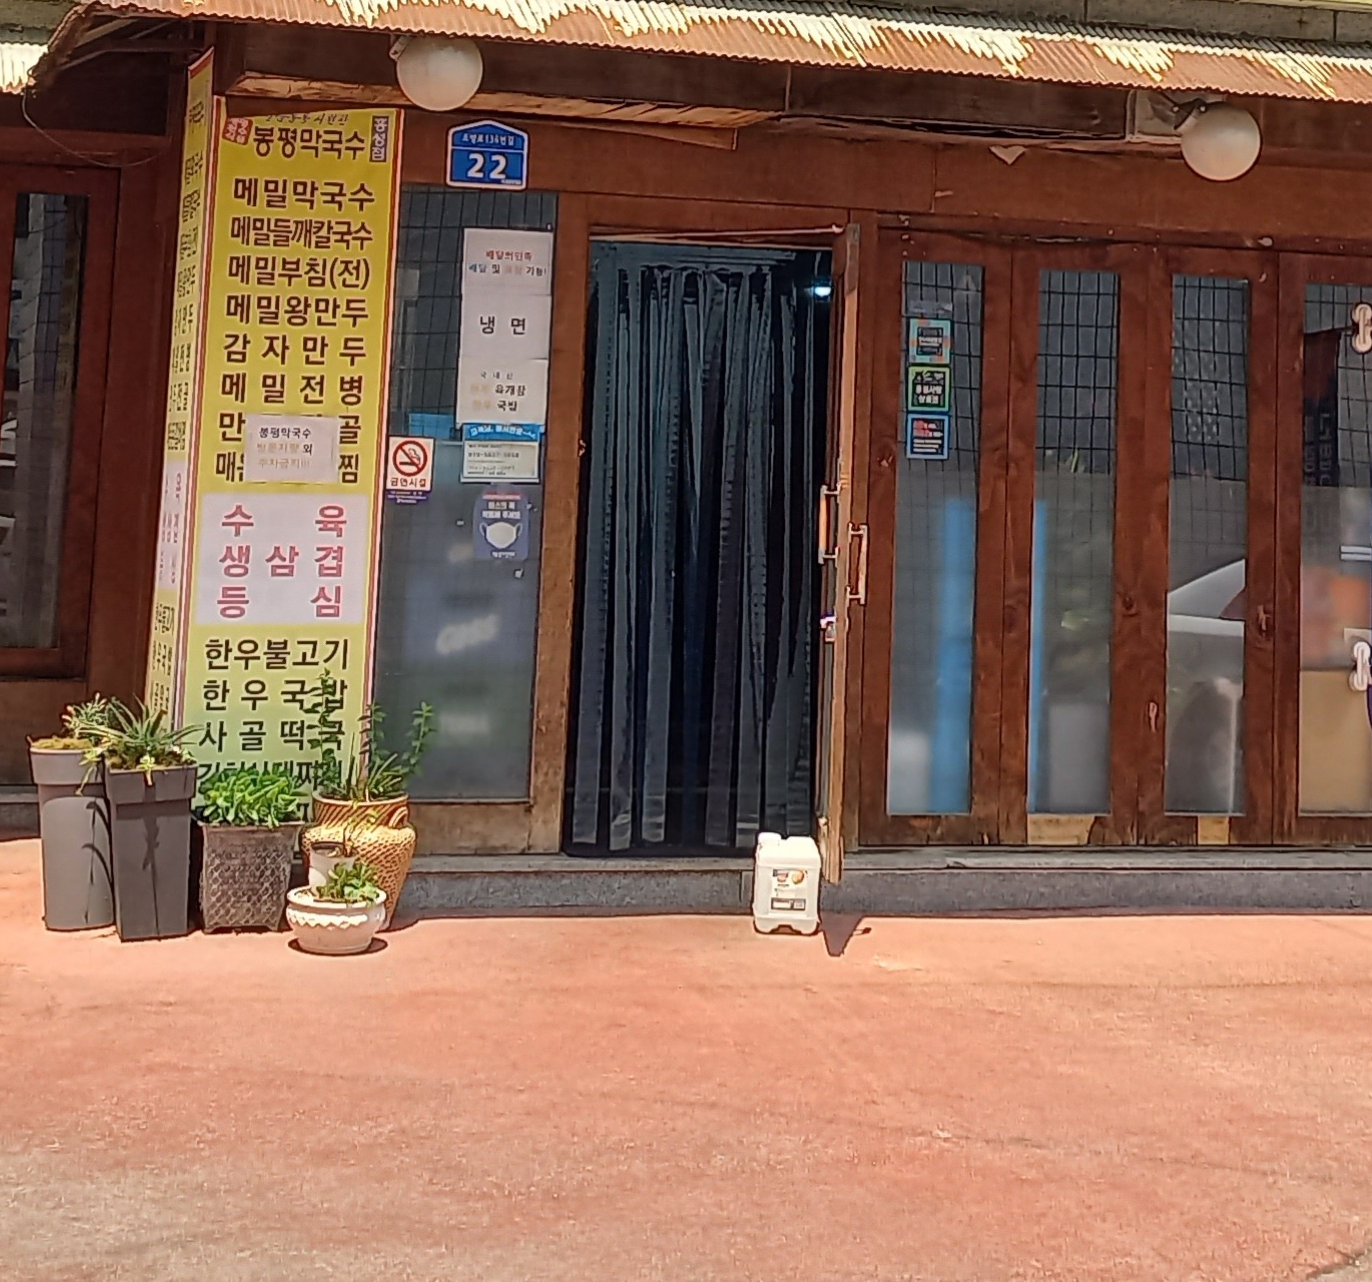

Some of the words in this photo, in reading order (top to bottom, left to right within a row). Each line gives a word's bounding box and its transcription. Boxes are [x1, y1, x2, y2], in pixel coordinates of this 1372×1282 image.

[253, 125, 366, 161] 봉평막국수
[467, 152, 507, 179] 22
[233, 177, 376, 212] 메밀막국수
[230, 216, 374, 251] 메밀들깨칼국수
[228, 255, 371, 290] 메밀부침(전)
[226, 294, 369, 328] 메밀왕만두
[259, 427, 312, 439] 봉평막국수
[390, 477, 427, 488] 금연시설
[204, 638, 350, 670] 한우불고기
